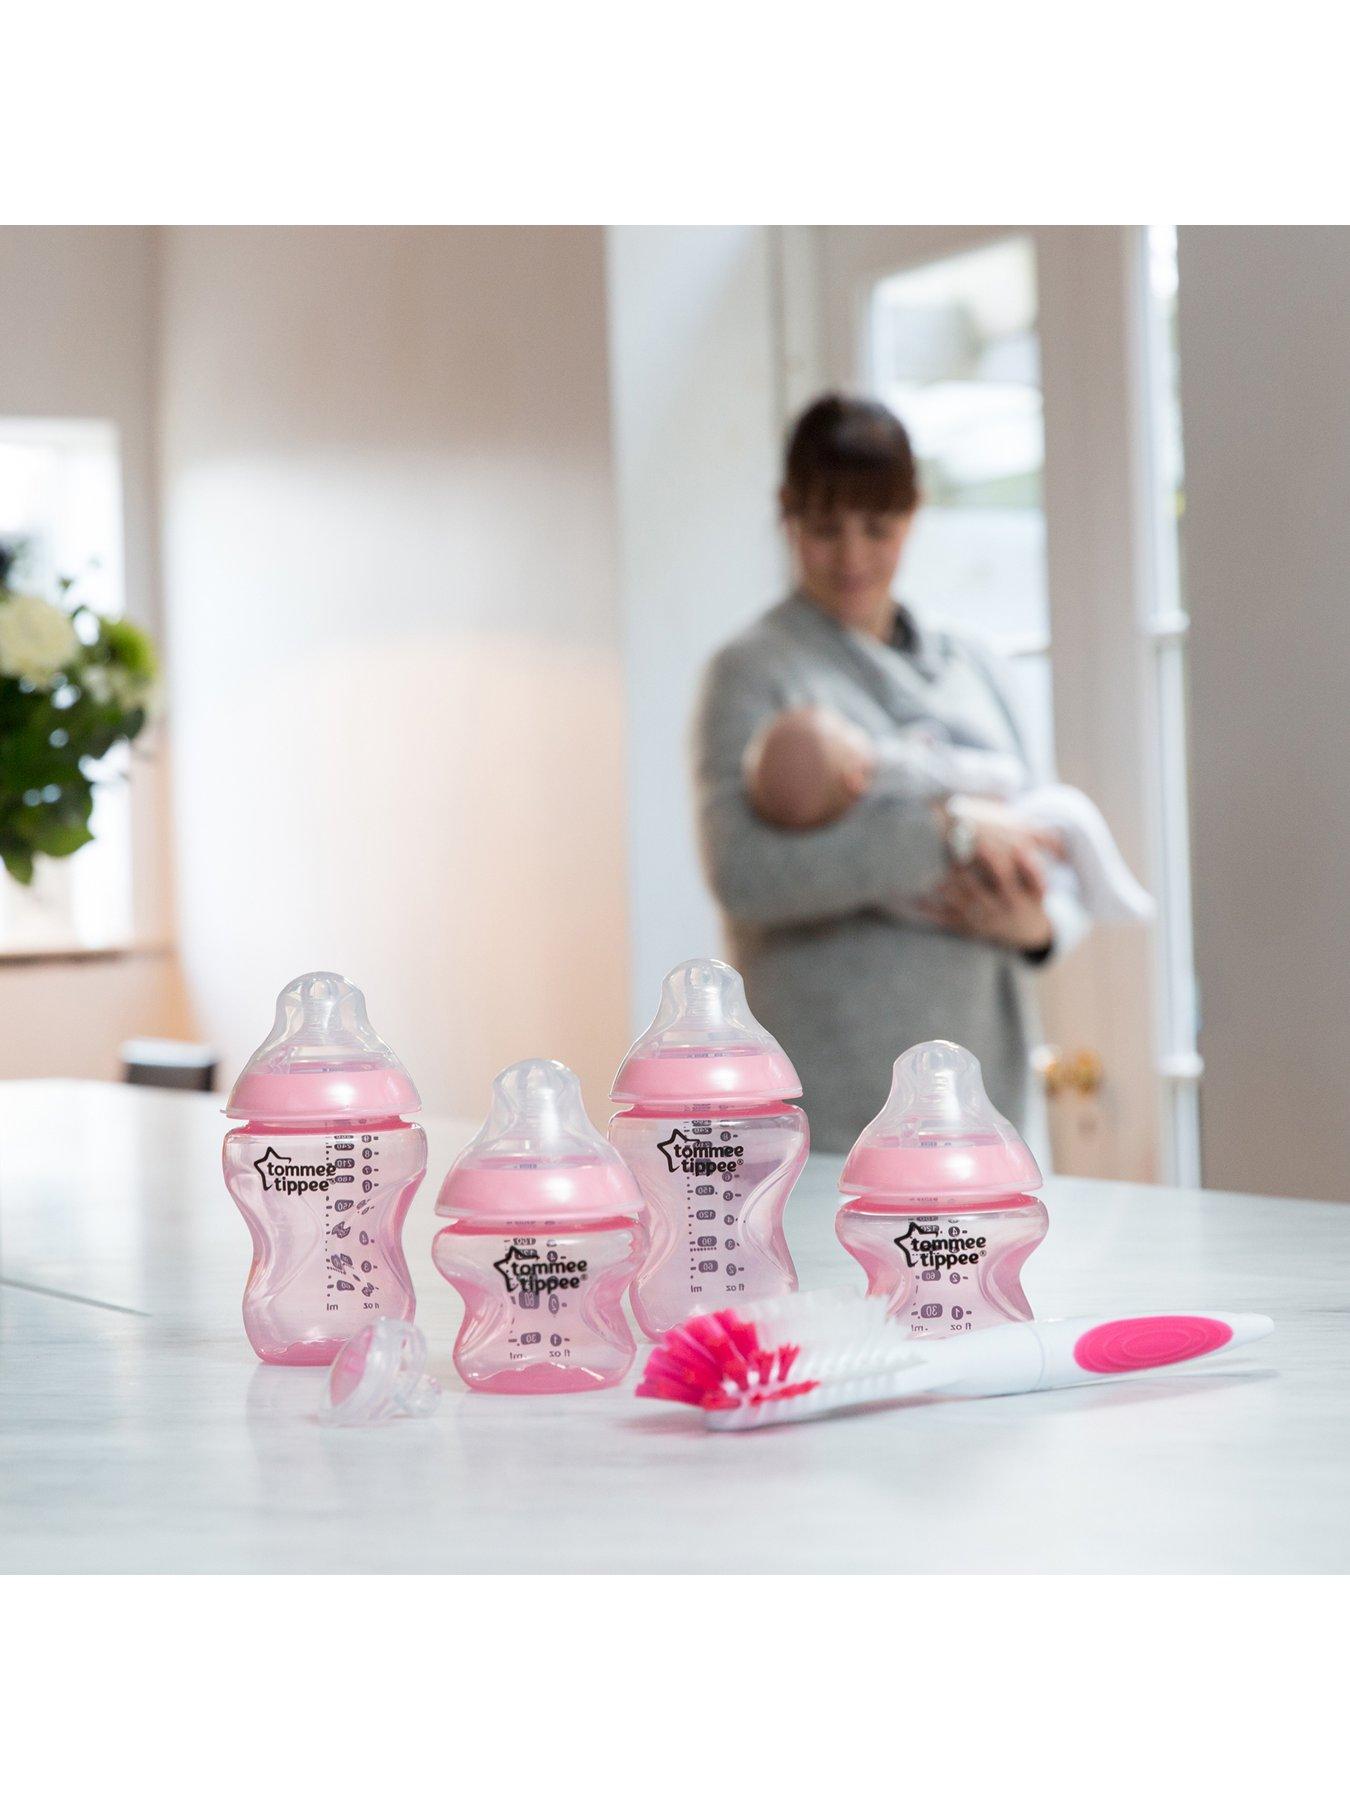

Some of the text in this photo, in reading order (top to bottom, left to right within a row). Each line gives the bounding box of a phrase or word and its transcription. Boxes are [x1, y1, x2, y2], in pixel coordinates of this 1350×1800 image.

[673, 1144, 744, 1158] tommee
[267, 1162, 336, 1177] tommee
[911, 1236, 987, 1252] tommee
[511, 1260, 588, 1276] tommee
